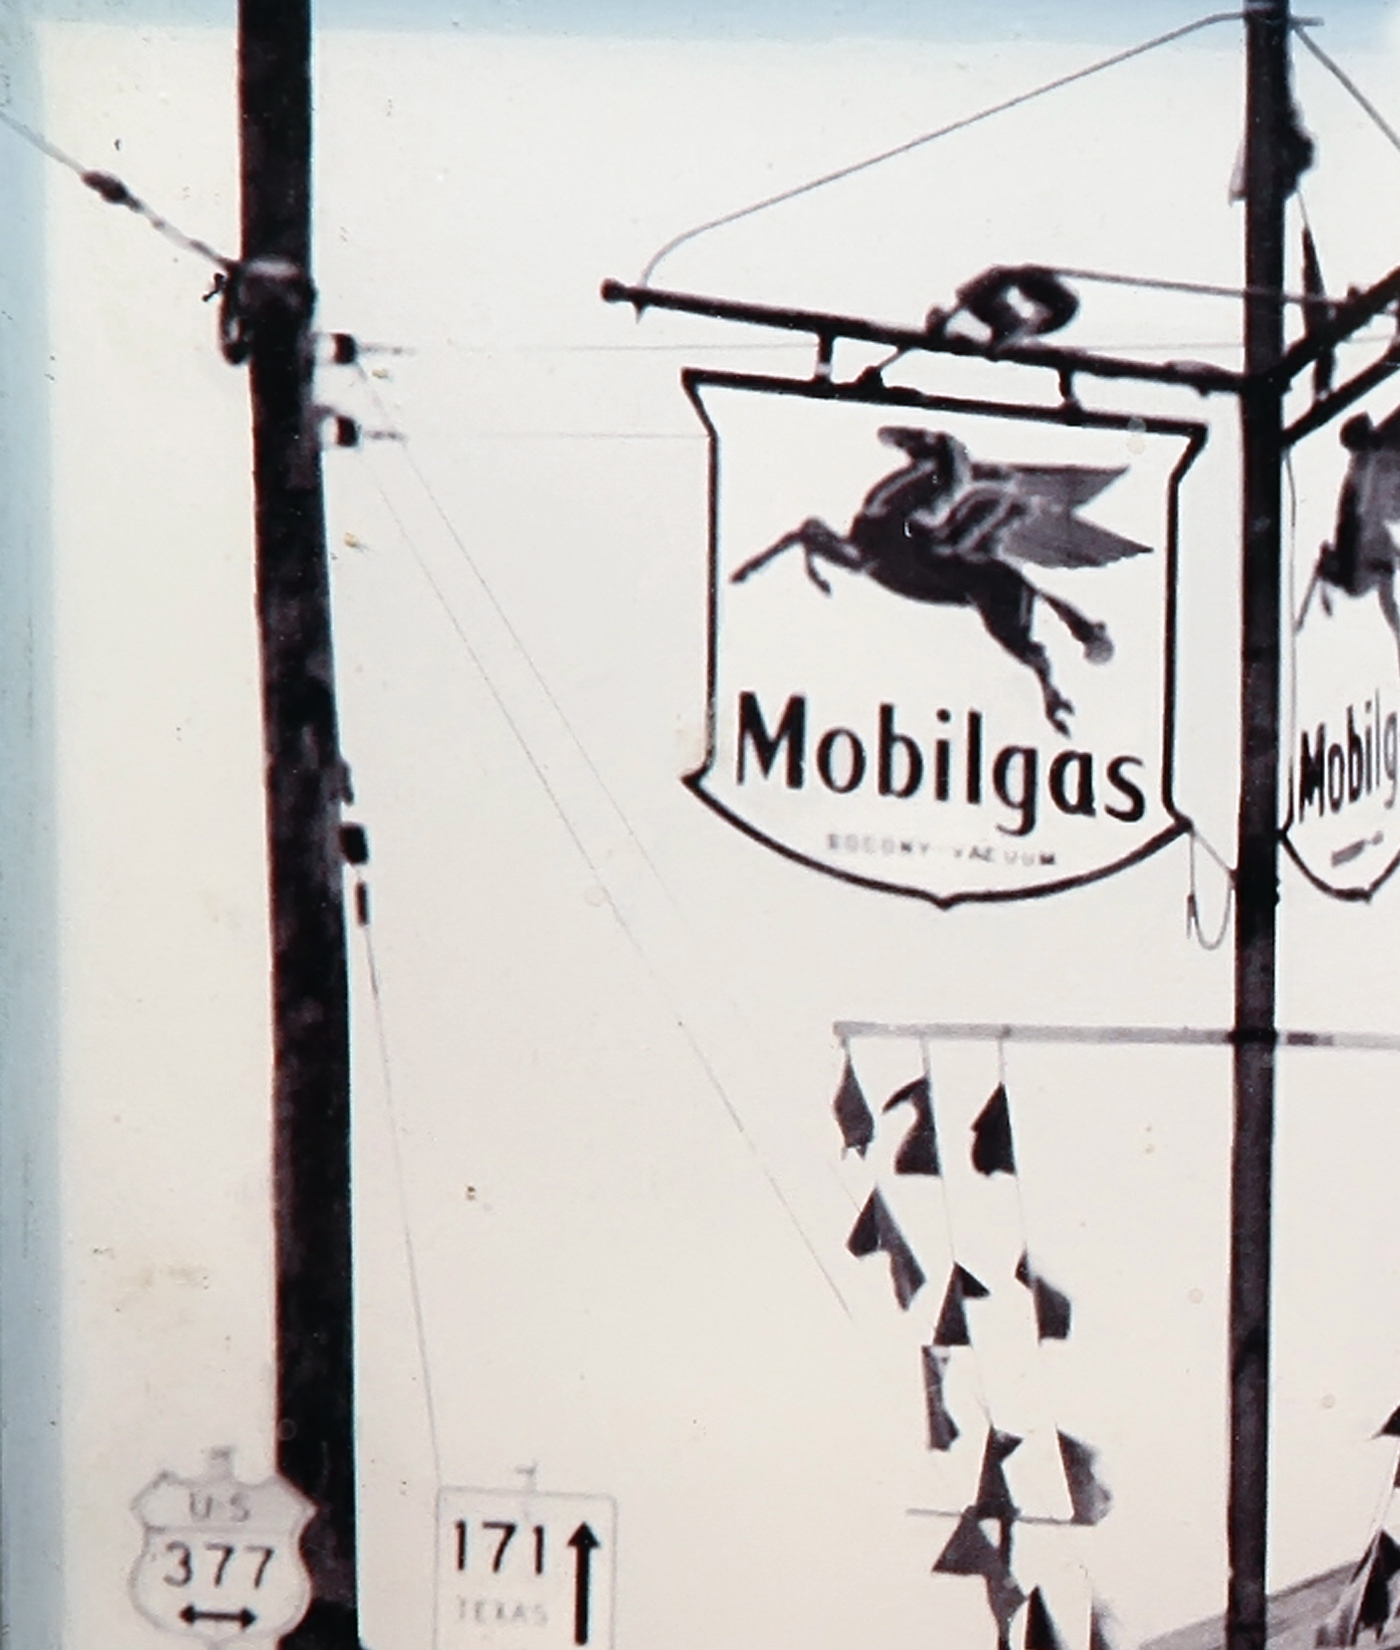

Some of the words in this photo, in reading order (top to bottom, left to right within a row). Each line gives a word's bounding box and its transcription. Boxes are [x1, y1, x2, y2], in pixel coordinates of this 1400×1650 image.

[735, 690, 1146, 837] Mobilgas
[162, 1541, 276, 1589] 377
[453, 1518, 546, 1575] 171
[456, 1596, 549, 1626] TEXAS
